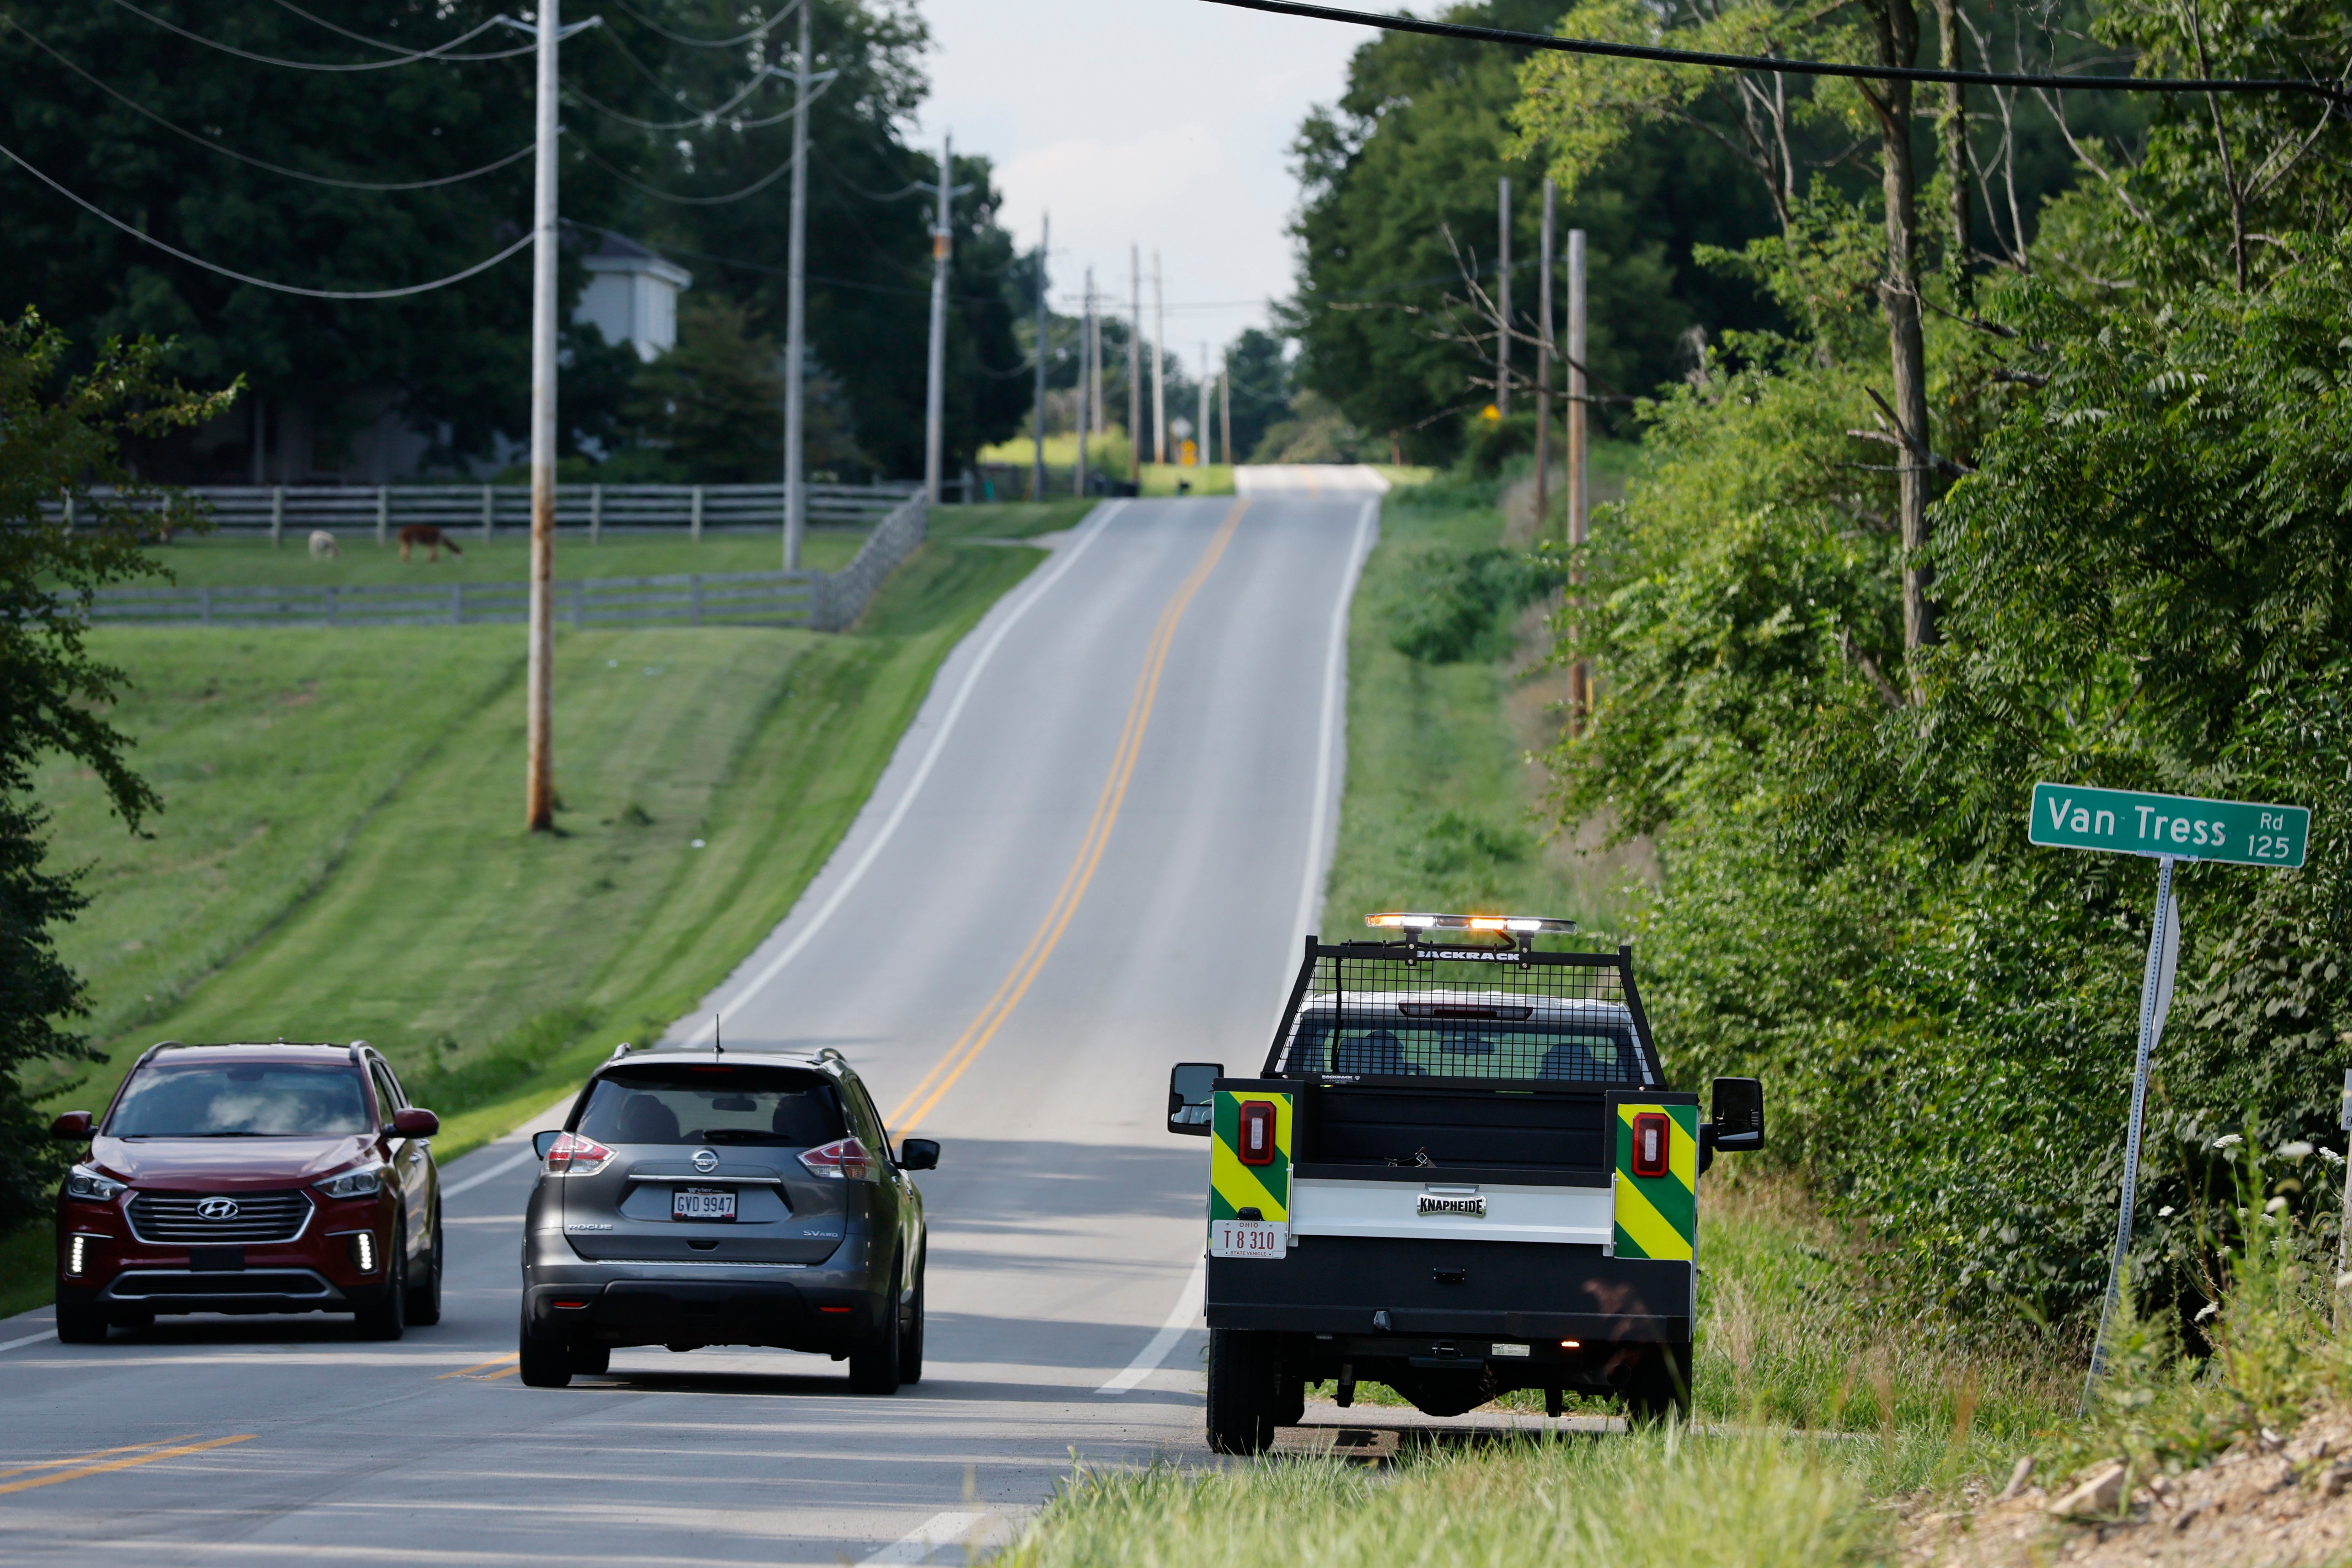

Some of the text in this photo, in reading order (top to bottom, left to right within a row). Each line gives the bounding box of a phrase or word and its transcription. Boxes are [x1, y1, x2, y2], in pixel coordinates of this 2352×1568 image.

[2048, 797, 2226, 846] Van Tress
[2260, 813, 2283, 831] Rd
[2248, 835, 2289, 859] 125
[678, 1196, 732, 1212] GVD 9947
[1420, 1197, 1483, 1215] KNAPHEIDE
[1224, 1231, 1274, 1250] T 8 310
